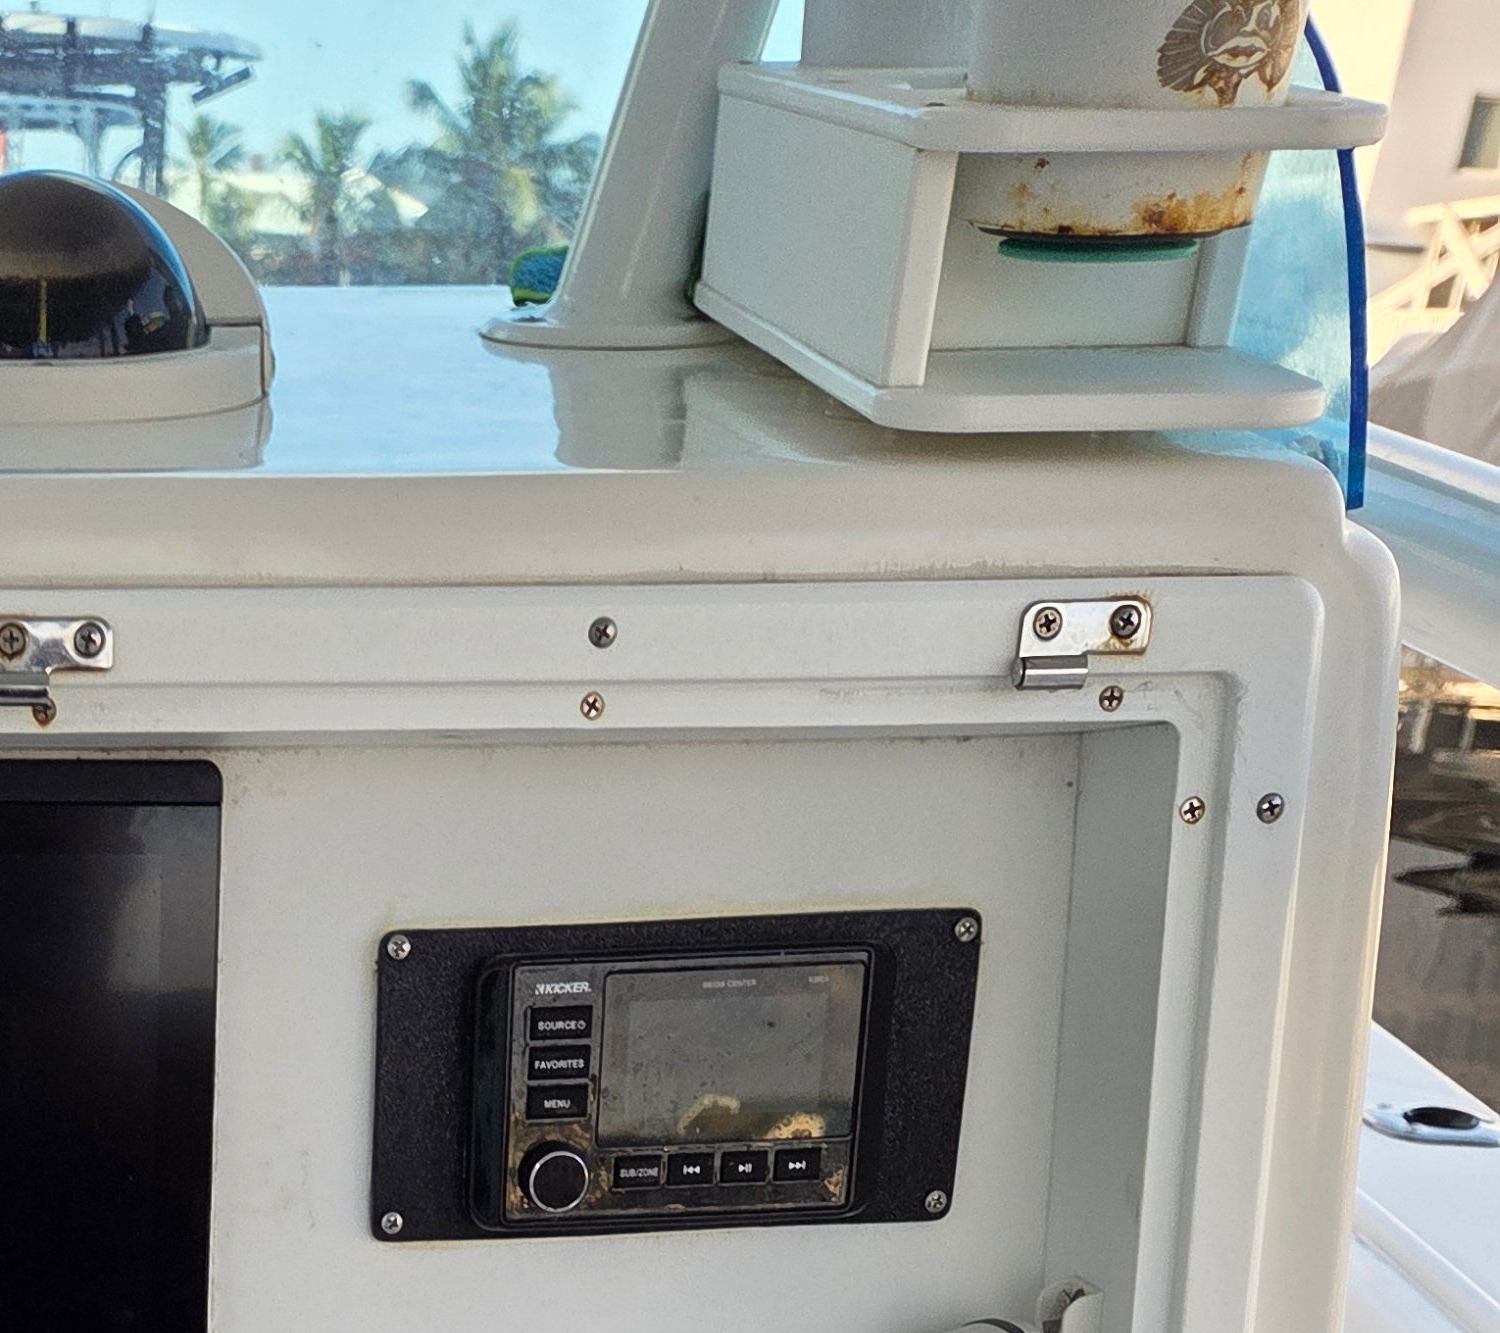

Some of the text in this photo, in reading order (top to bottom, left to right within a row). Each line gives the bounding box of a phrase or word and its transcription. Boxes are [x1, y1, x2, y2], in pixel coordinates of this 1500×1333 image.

[537, 1020, 578, 1031] SOURCE
[533, 1058, 585, 1070] FAVORITES
[543, 1099, 571, 1109] MENU
